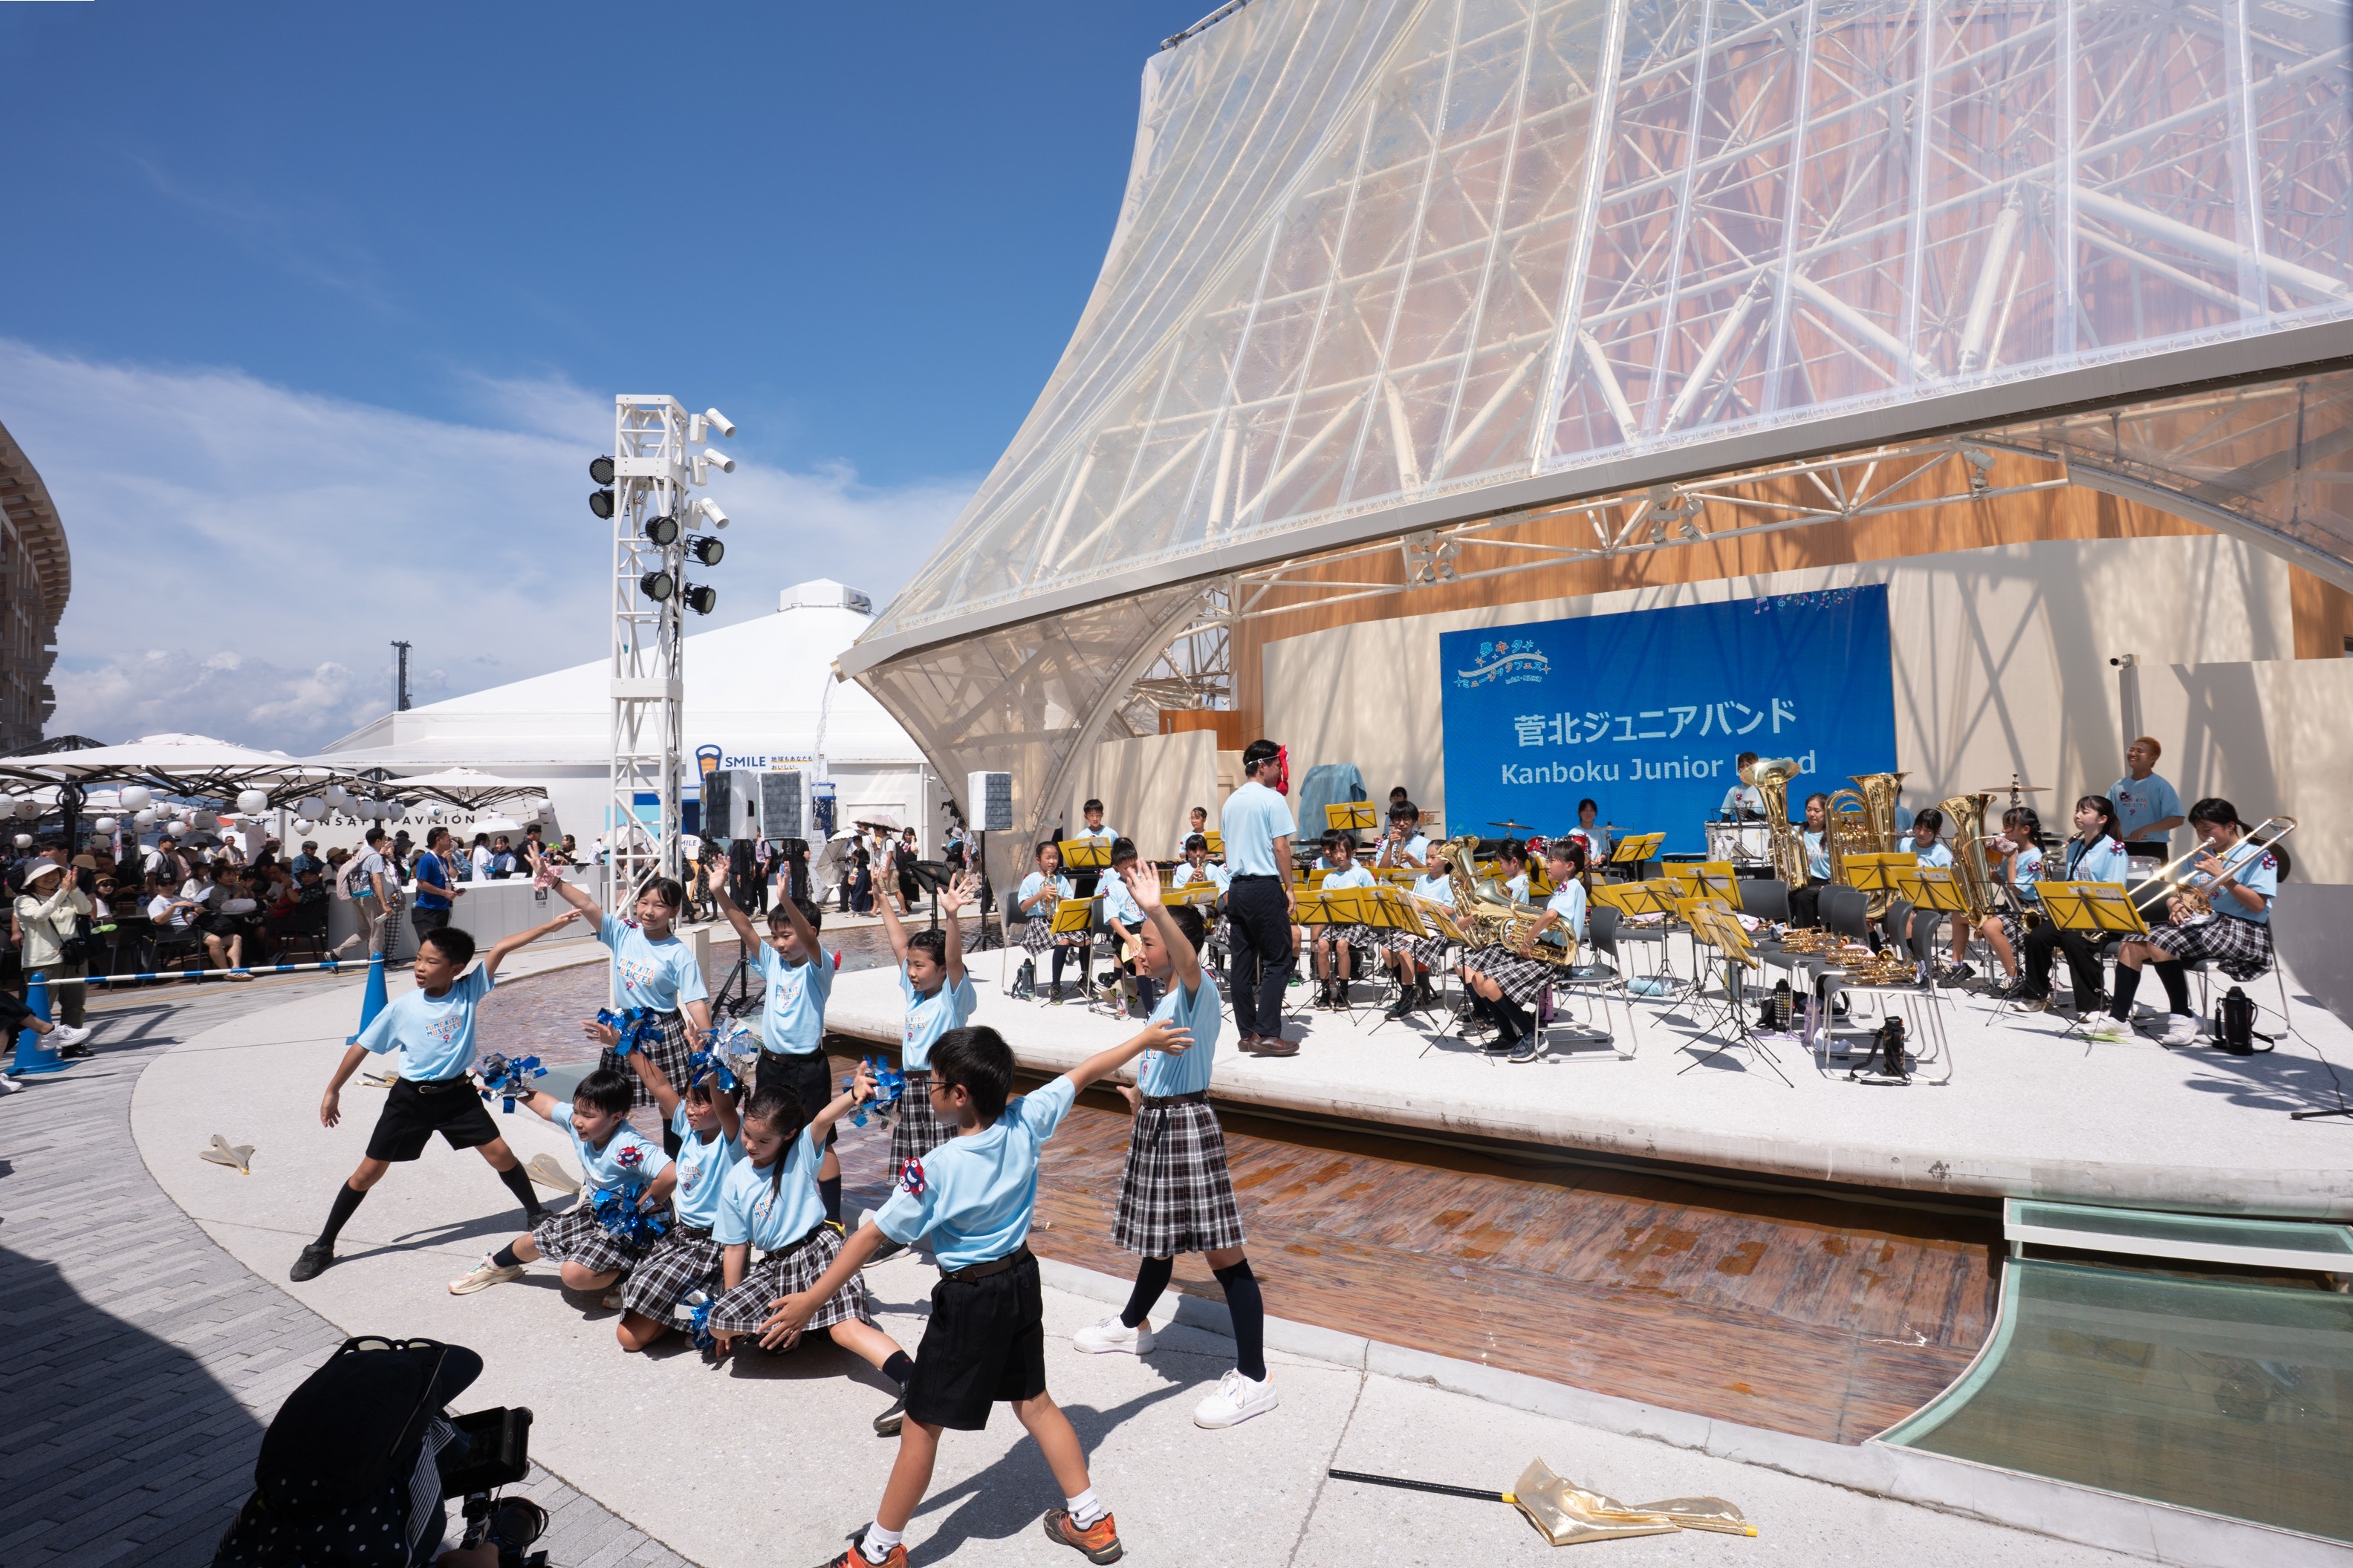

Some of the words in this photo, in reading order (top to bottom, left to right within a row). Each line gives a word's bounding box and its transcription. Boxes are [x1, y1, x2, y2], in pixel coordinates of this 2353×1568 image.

[1514, 697, 1797, 747] 菅北ジュニアバンド
[725, 756, 766, 767] SMILE
[1502, 760, 1620, 784] Kanboku
[1629, 755, 1724, 781] Junior
[291, 817, 366, 827] KNSAI
[617, 965, 652, 986] MUSICFES
[618, 957, 640, 971] YUME
[637, 966, 655, 977] KITA
[424, 1021, 444, 1032] YUME
[444, 1016, 460, 1026] KITA
[426, 1021, 461, 1038] MUSICFES
